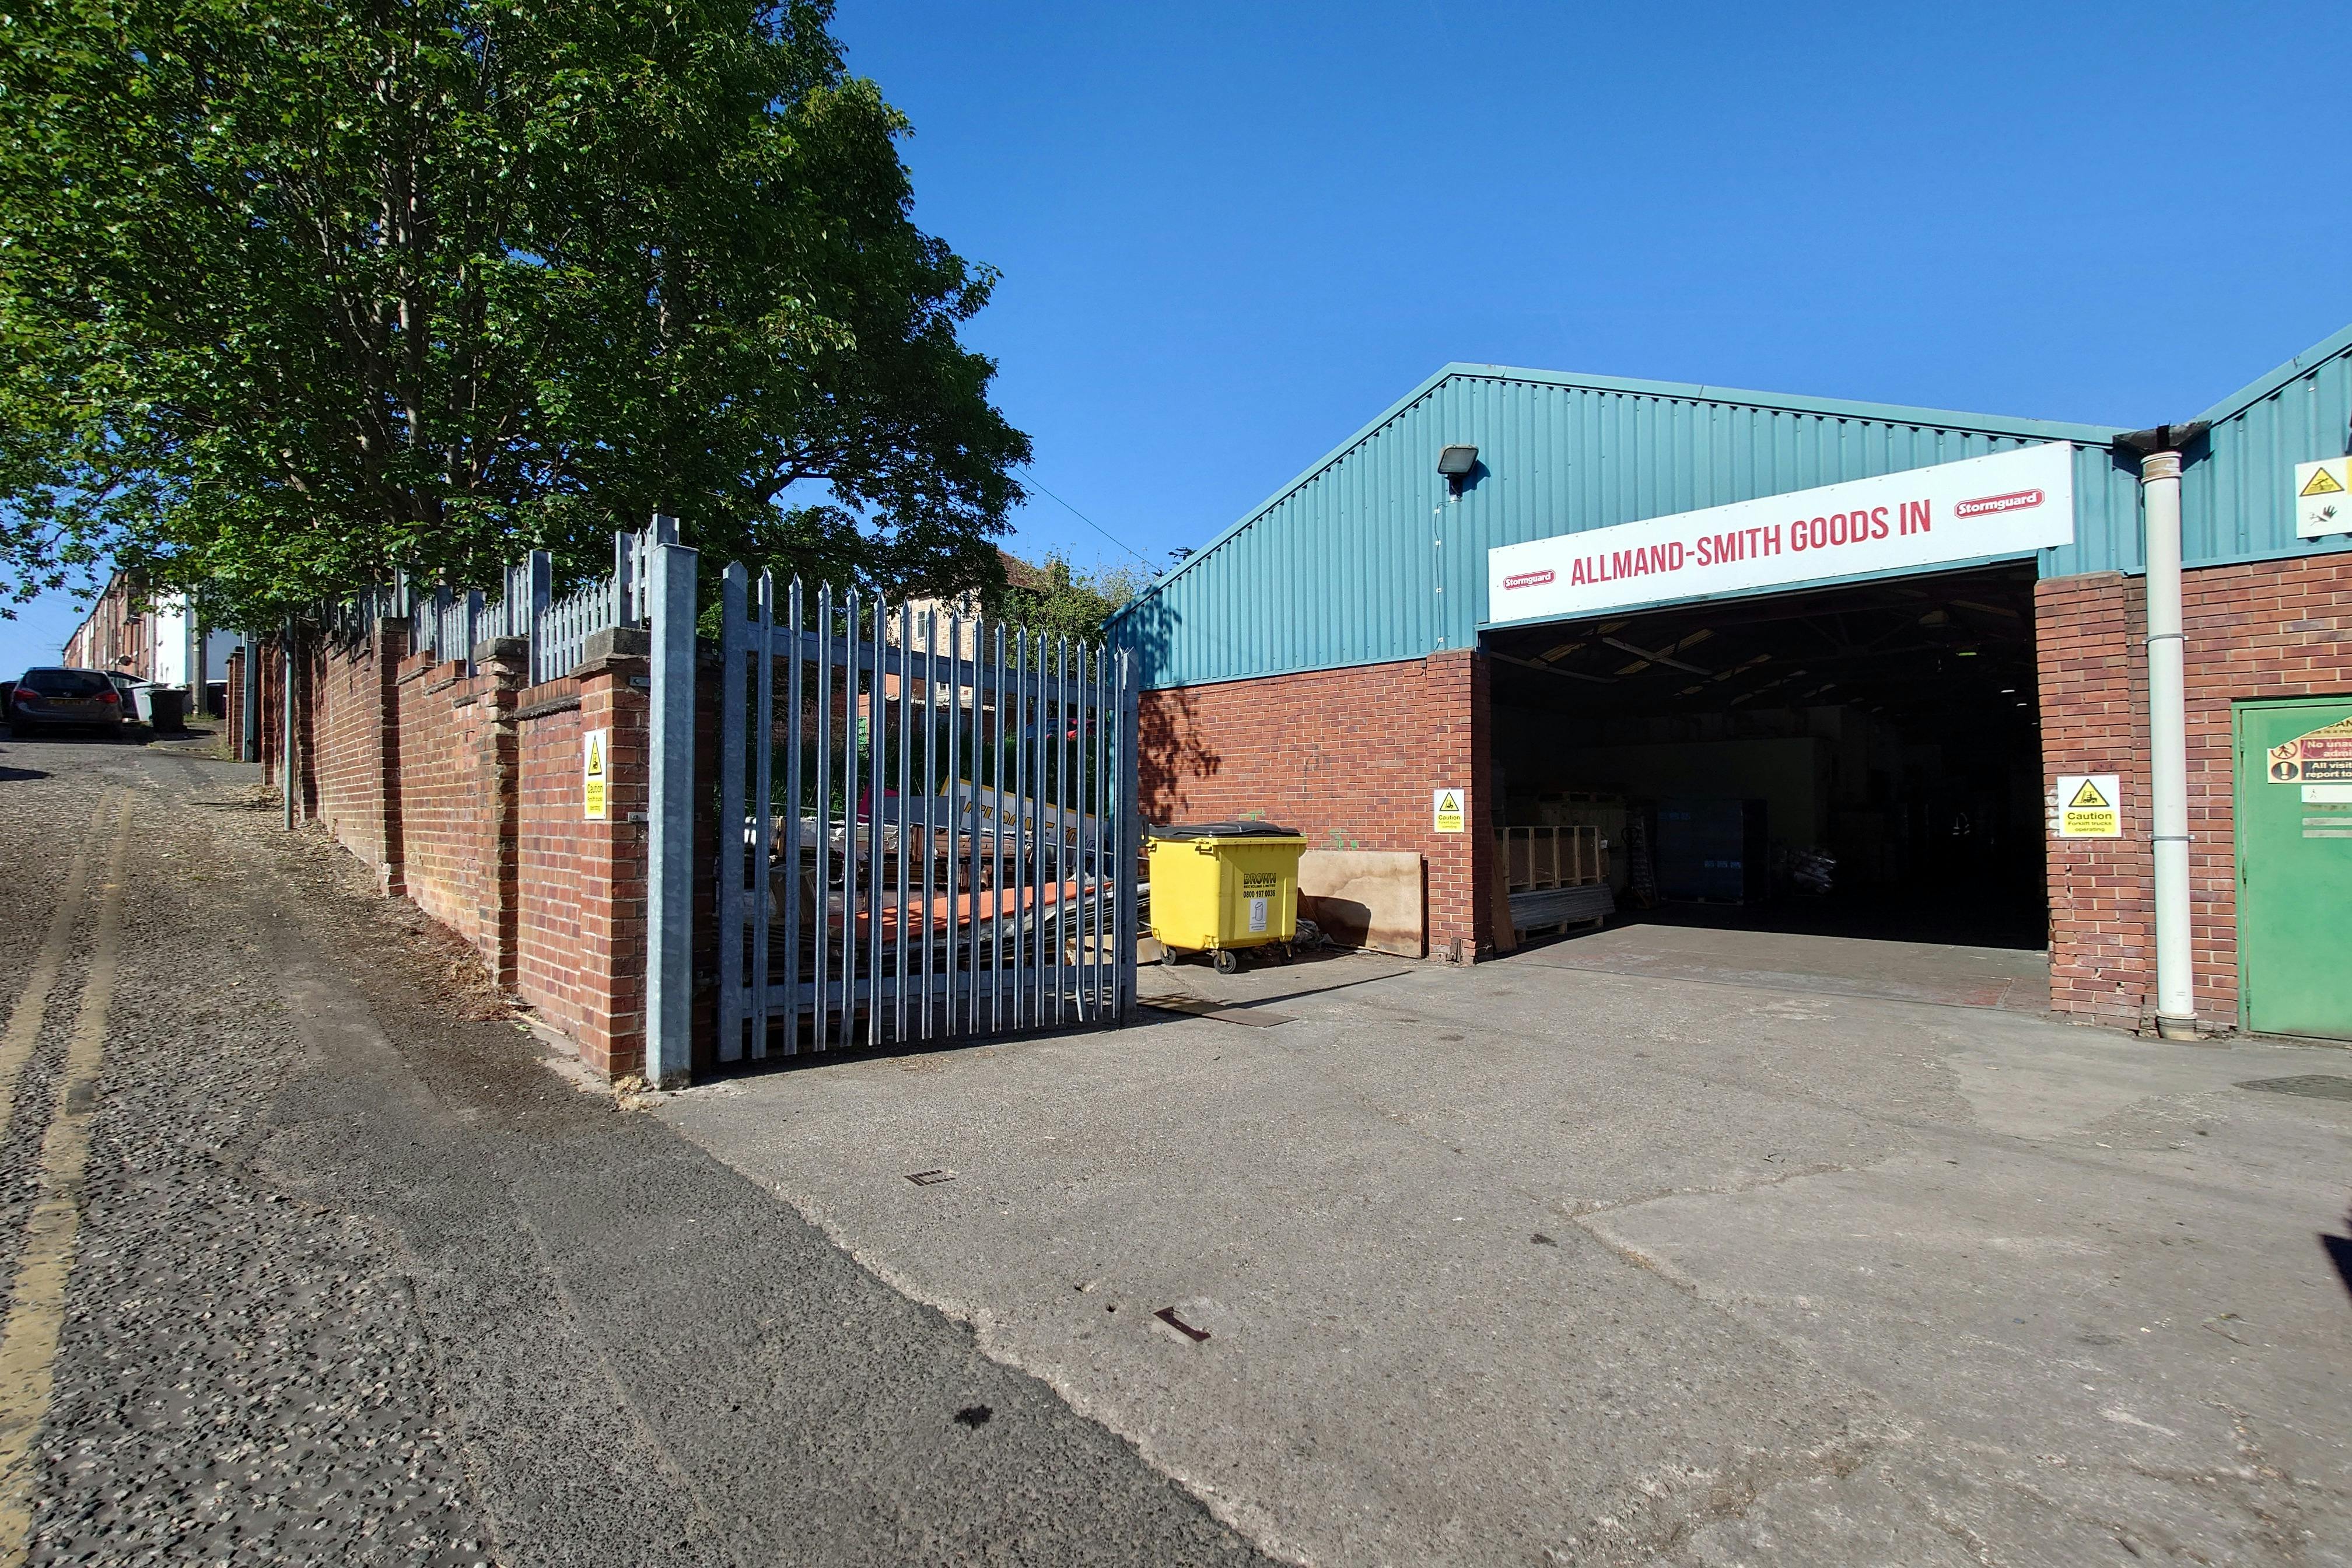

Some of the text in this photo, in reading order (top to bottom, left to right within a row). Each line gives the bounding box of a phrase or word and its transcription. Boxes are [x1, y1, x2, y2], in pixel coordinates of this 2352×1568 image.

[1958, 492, 2038, 515] Stormguard
[1570, 499, 1931, 586] ALLMAND-SMITH GOODS IN
[1506, 572, 1551, 587] Stormguard
[1244, 873, 1276, 884] BROWN
[1243, 890, 1255, 898] 0800
